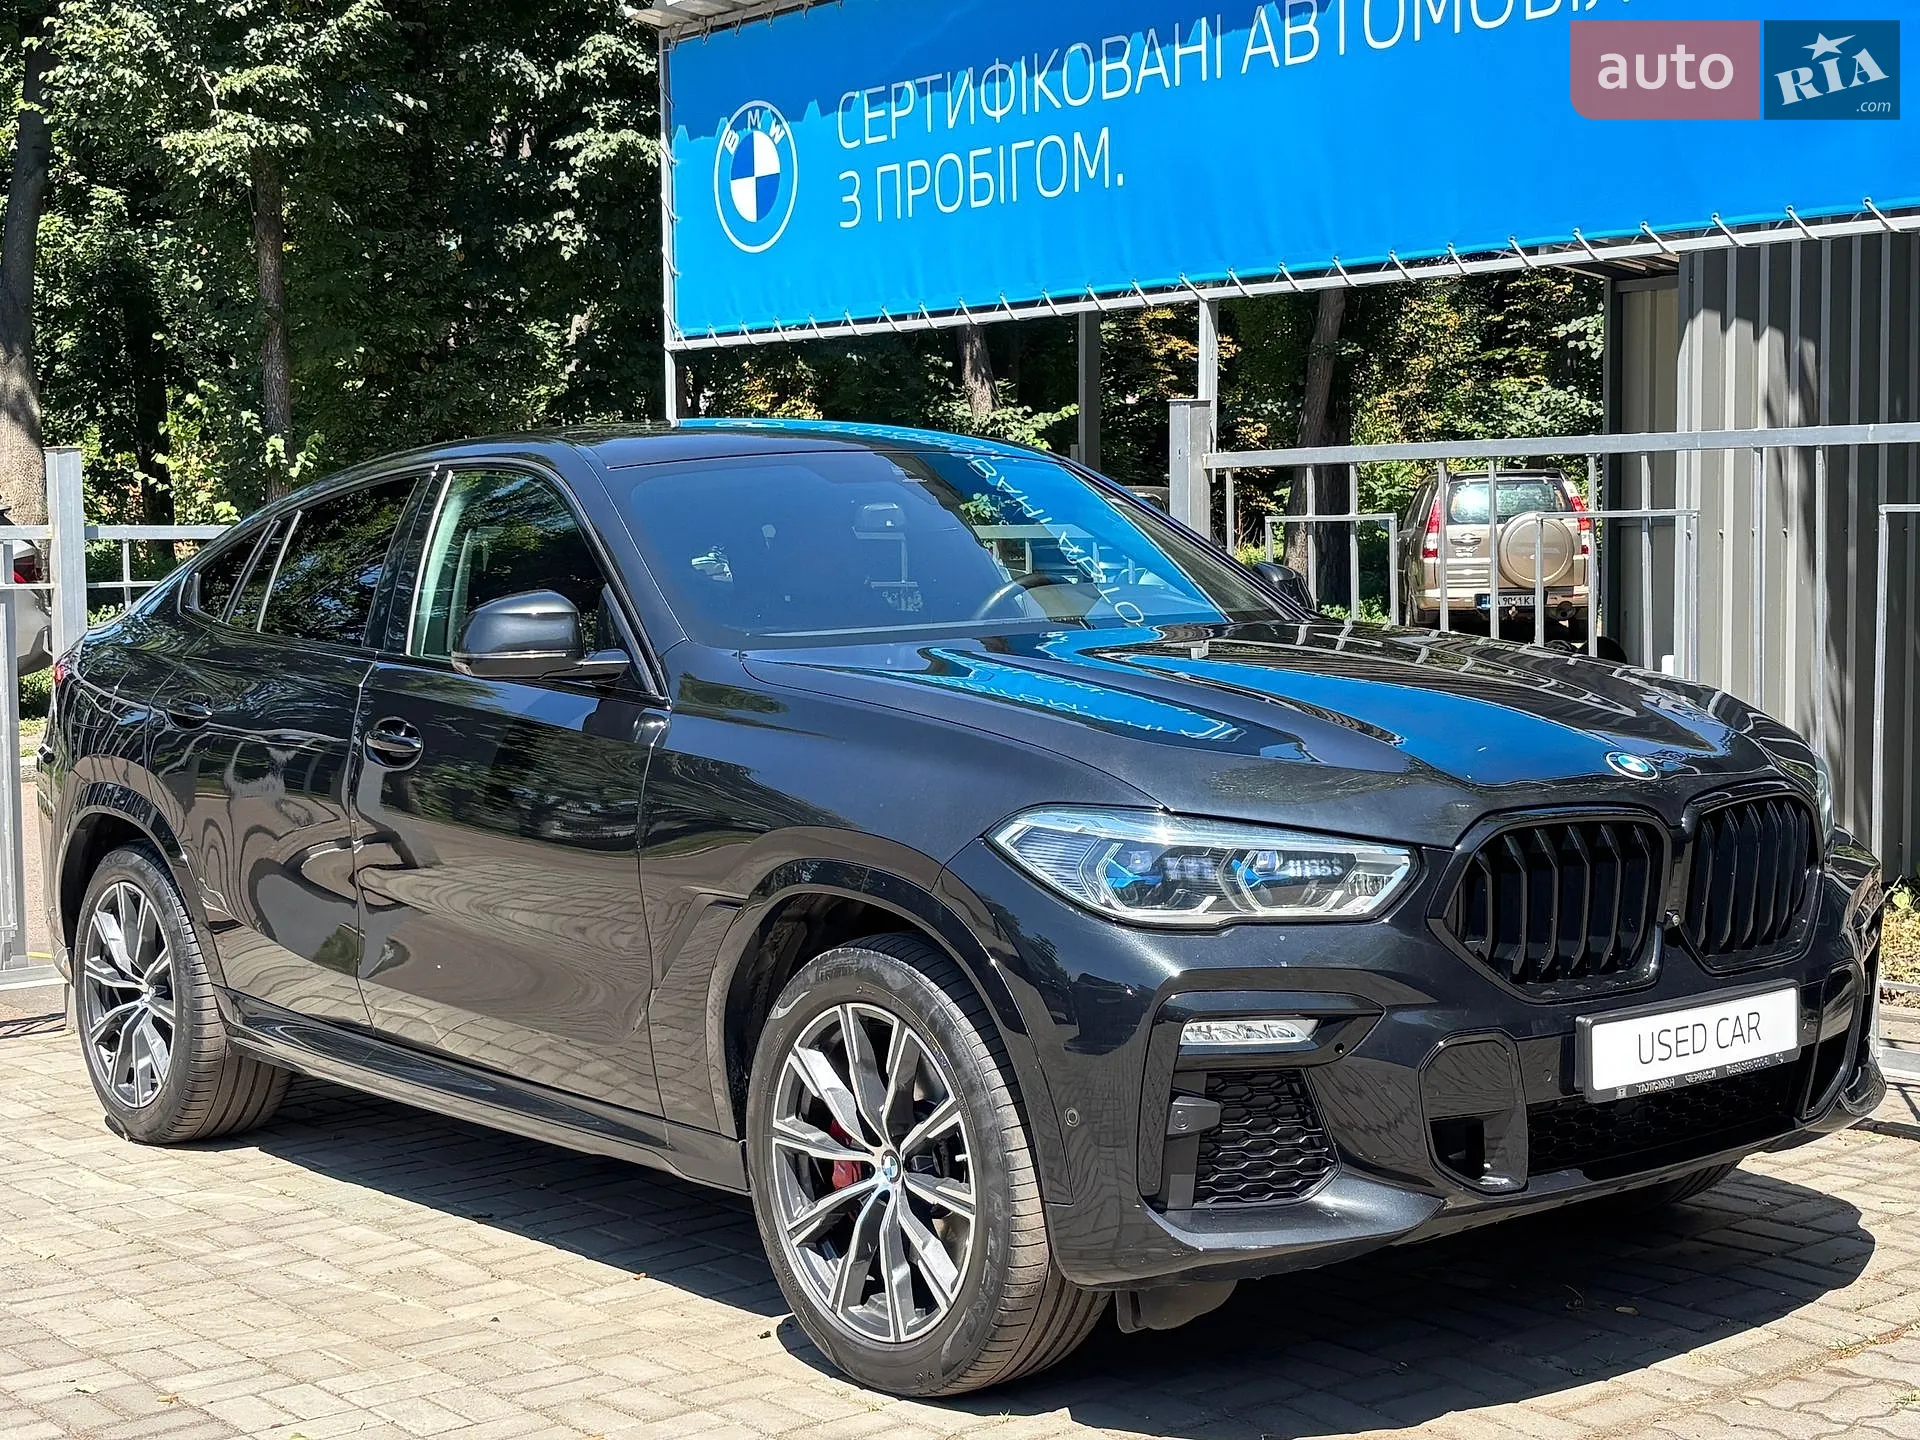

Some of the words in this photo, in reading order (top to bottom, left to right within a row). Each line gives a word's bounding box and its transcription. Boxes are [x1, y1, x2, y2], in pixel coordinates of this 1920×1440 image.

[836, 14, 1222, 150] СЕРТИФІКОВАНІ
[724, 109, 786, 156] BMW
[875, 127, 1125, 223] ПРОБІГОМ.
[1637, 1022, 1708, 1065] USED
[1715, 1011, 1762, 1050] CAR
